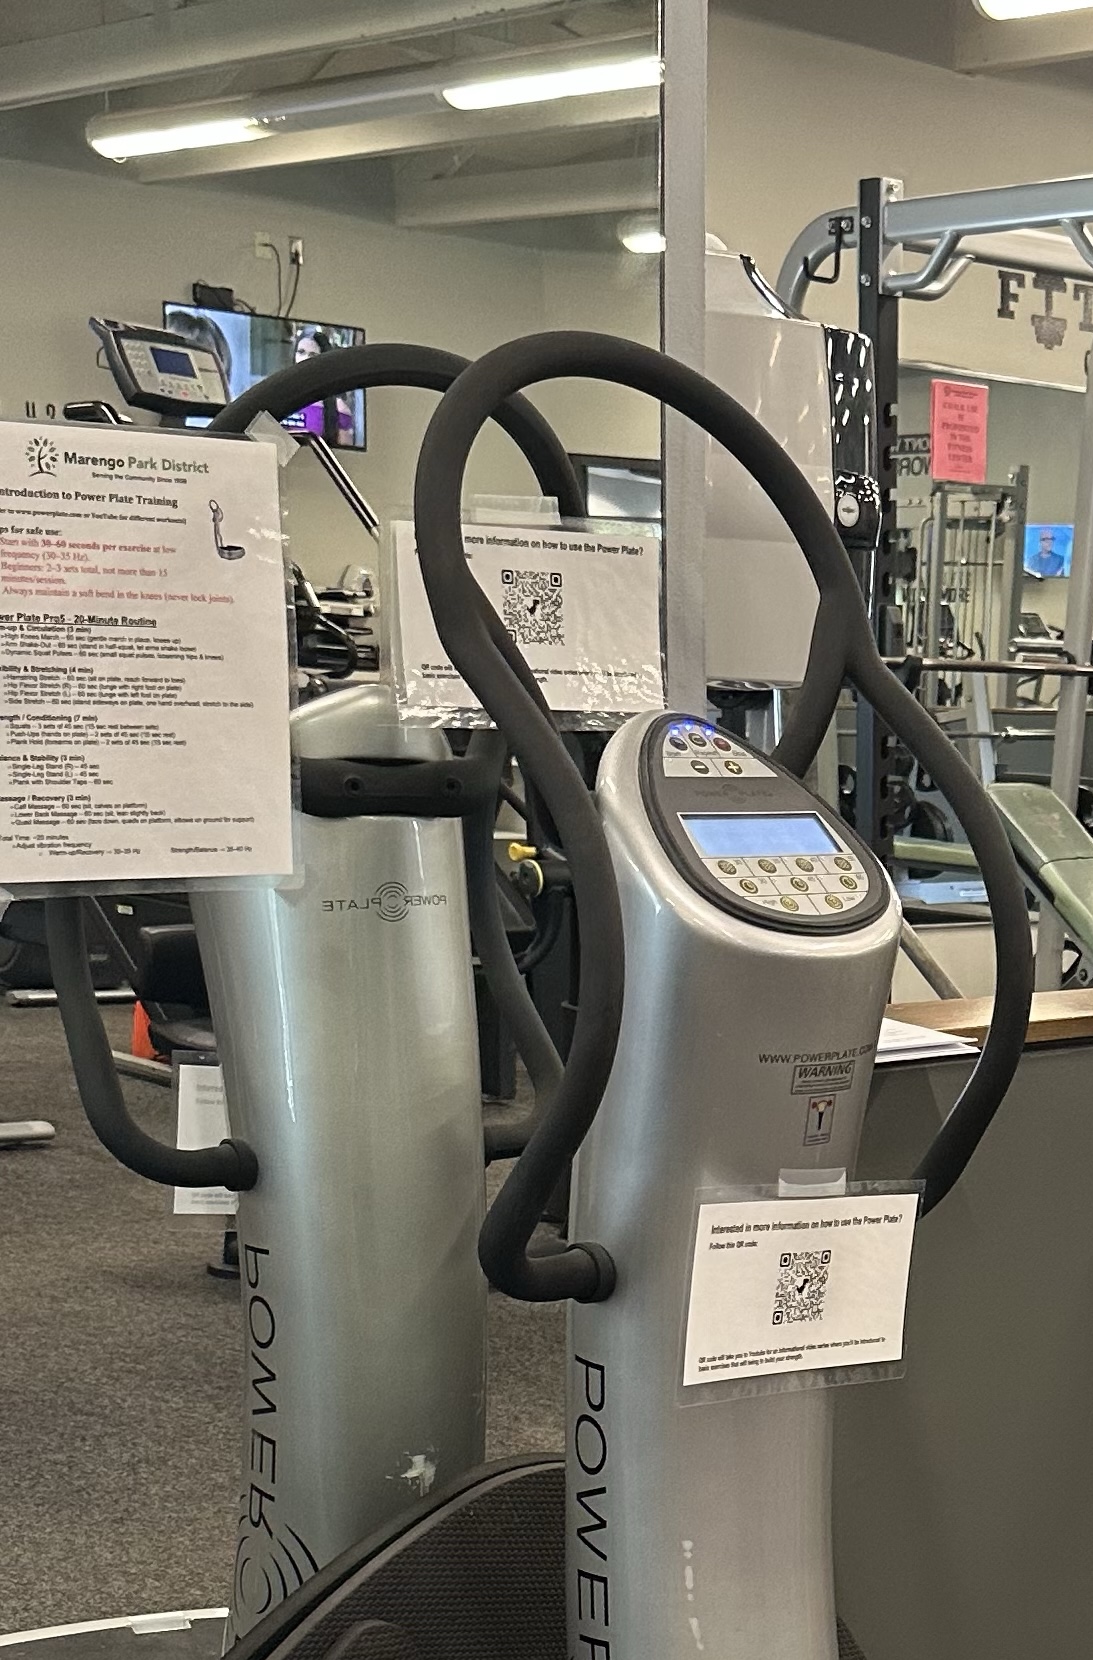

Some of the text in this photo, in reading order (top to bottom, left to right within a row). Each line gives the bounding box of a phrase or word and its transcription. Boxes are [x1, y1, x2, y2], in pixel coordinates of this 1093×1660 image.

[64, 452, 209, 473] Marengo Park District
[0, 488, 178, 509] ntroduction to Power Plate Training
[11, 526, 24, 534] for
[26, 527, 43, 535] safe
[22, 538, 39, 546] with
[68, 542, 100, 550] seconds
[103, 544, 116, 552] per
[464, 536, 484, 544] more
[486, 535, 529, 547] information
[531, 540, 541, 548] on
[543, 540, 558, 549] how
[560, 542, 567, 550] to
[584, 543, 595, 552] the
[597, 543, 620, 554] Power
[621, 545, 644, 556] Plate?
[140, 568, 156, 576] than
[2, 586, 33, 597] Always
[126, 591, 138, 599] the
[17, 613, 40, 622] Plate
[798, 1062, 852, 1078] WARNING
[711, 1224, 744, 1234] Interested
[745, 1223, 751, 1232] in
[772, 1221, 809, 1230] information
[820, 1219, 833, 1228] how
[834, 1219, 840, 1227] to
[853, 1217, 862, 1225] the
[863, 1216, 882, 1224] Power
